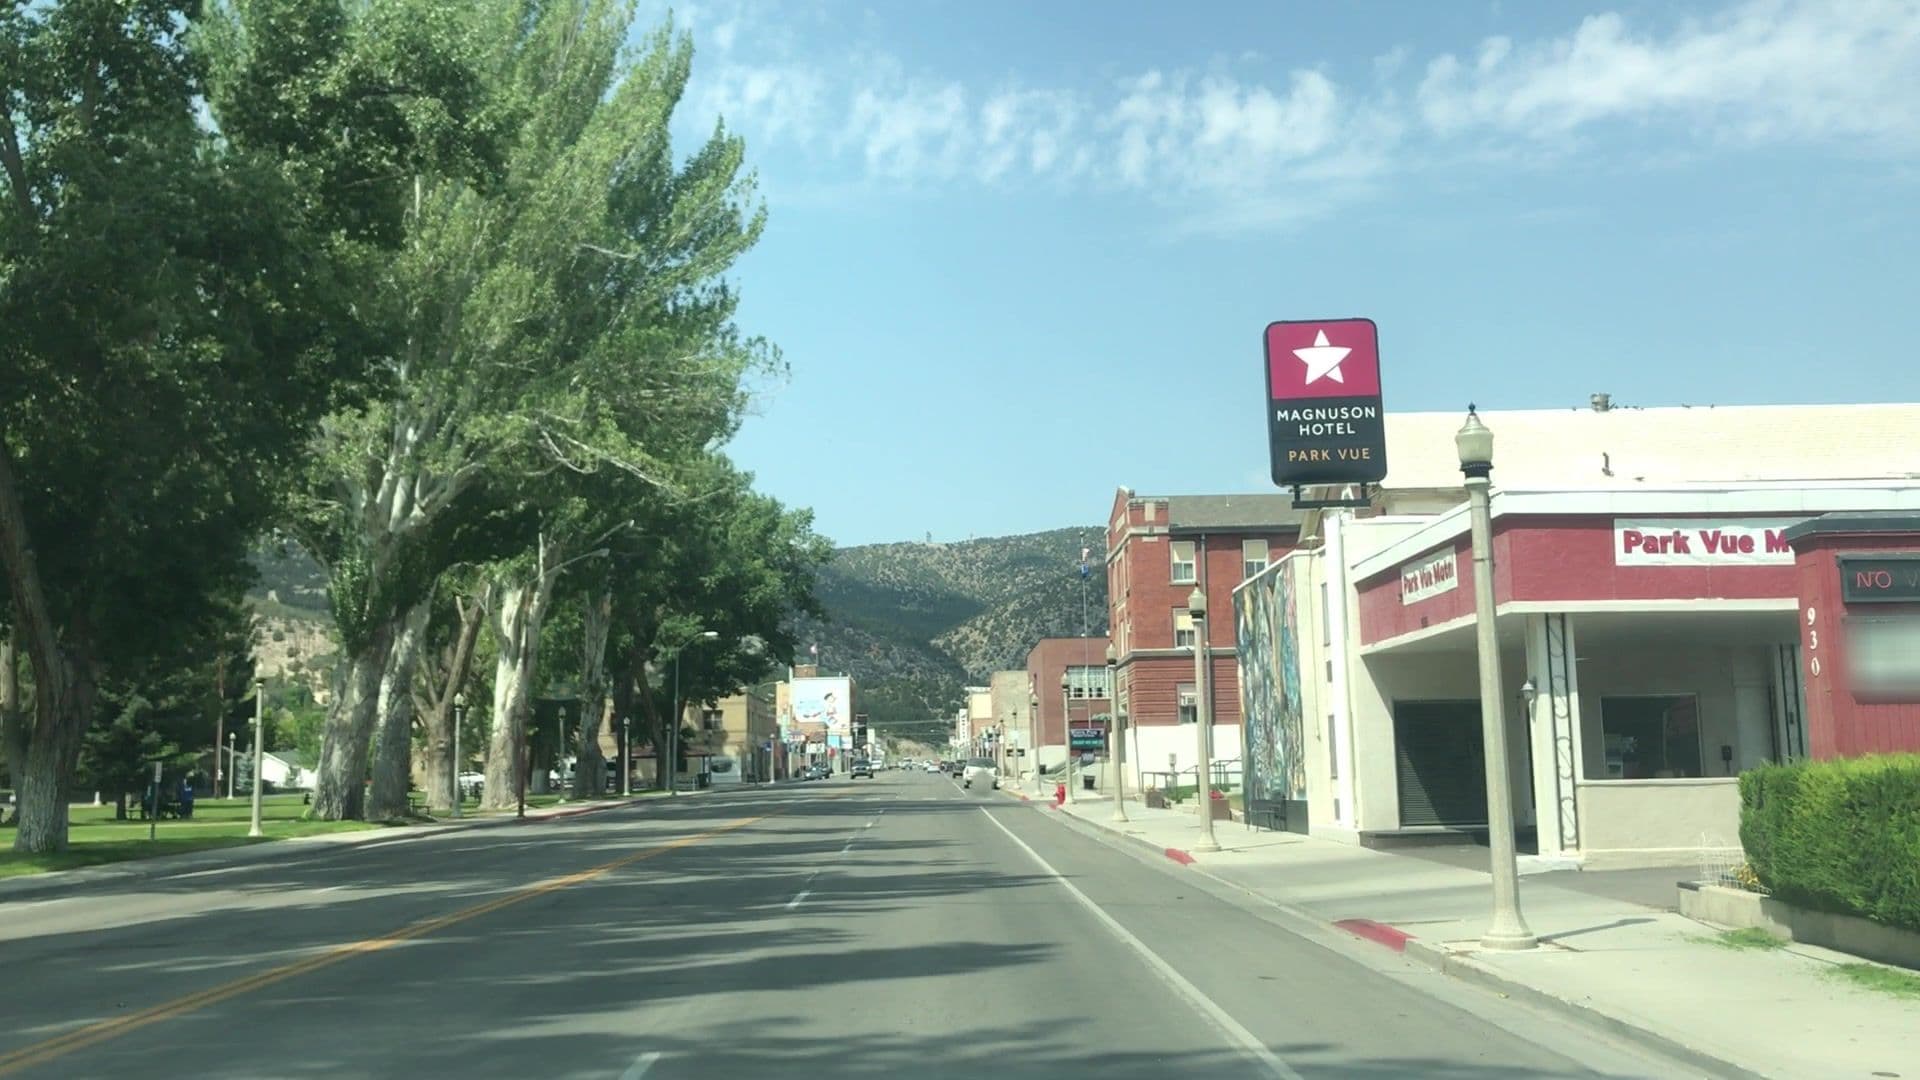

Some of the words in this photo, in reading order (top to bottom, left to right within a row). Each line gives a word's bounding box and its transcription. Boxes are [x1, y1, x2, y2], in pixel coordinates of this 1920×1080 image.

[1277, 407, 1375, 421] MAGNUSON
[1300, 423, 1355, 436] HOTEL
[1288, 449, 1331, 462] PARK
[1338, 448, 1370, 460] VUE
[1623, 530, 1691, 554] Park
[1700, 530, 1755, 554] Vue
[1857, 571, 1892, 588] NO
